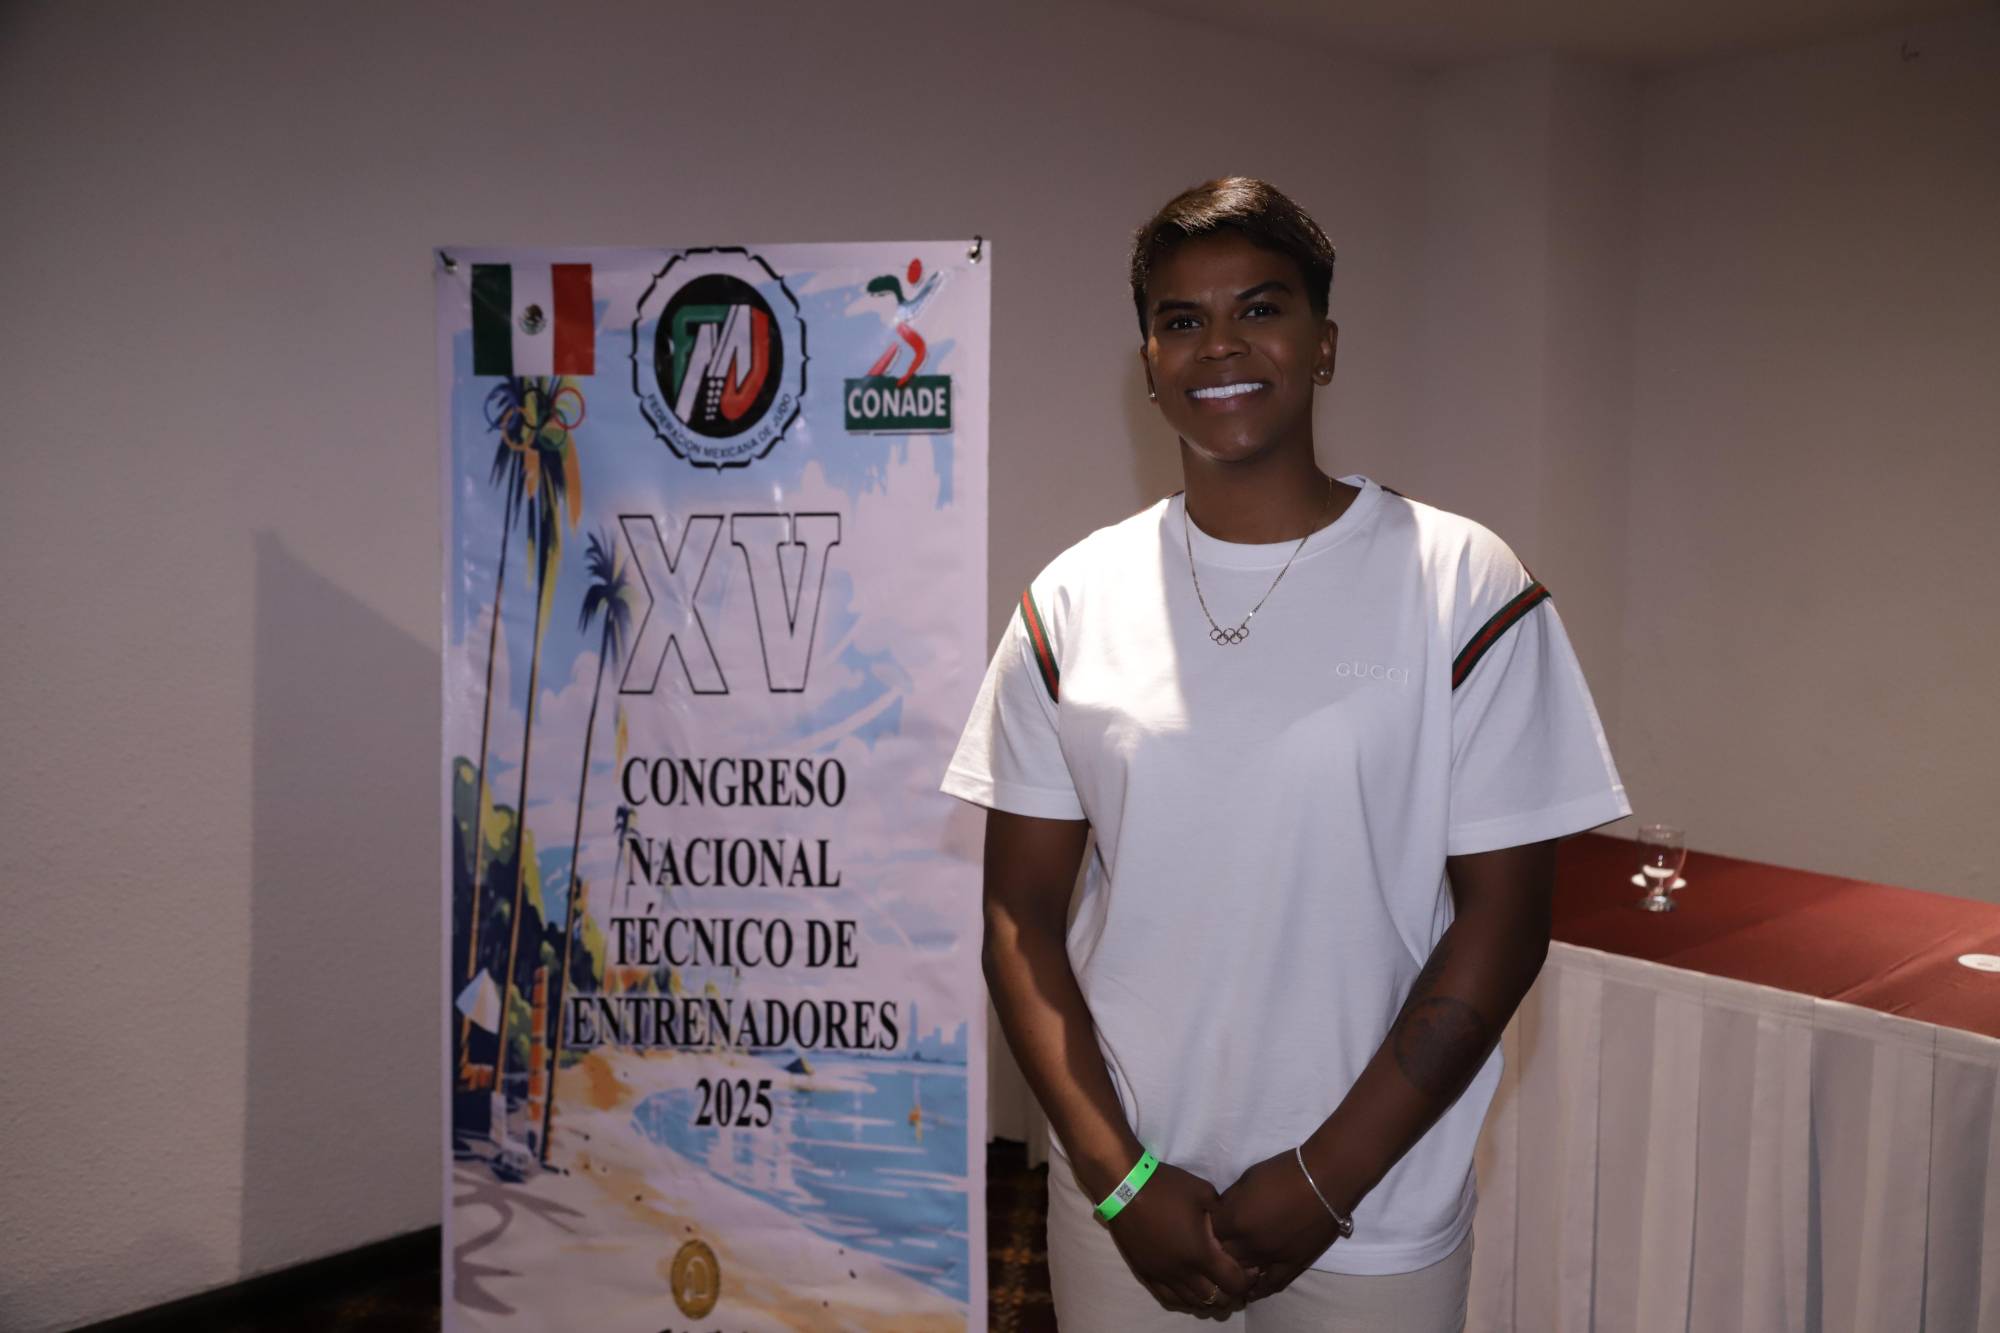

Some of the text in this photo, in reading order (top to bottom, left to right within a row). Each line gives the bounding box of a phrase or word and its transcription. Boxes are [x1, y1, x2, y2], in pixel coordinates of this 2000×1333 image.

[703, 438, 758, 459] MEXICANA
[759, 428, 772, 442] DE
[772, 393, 792, 427] JUDO
[848, 387, 947, 418] CONADE
[618, 512, 842, 695] XV
[621, 757, 847, 807] CONGRESO
[625, 838, 841, 888] NACIONAL
[611, 903, 859, 969] TÉCNICO DE
[572, 997, 899, 1050] ENTRENADORES
[694, 1079, 773, 1127] 2025
